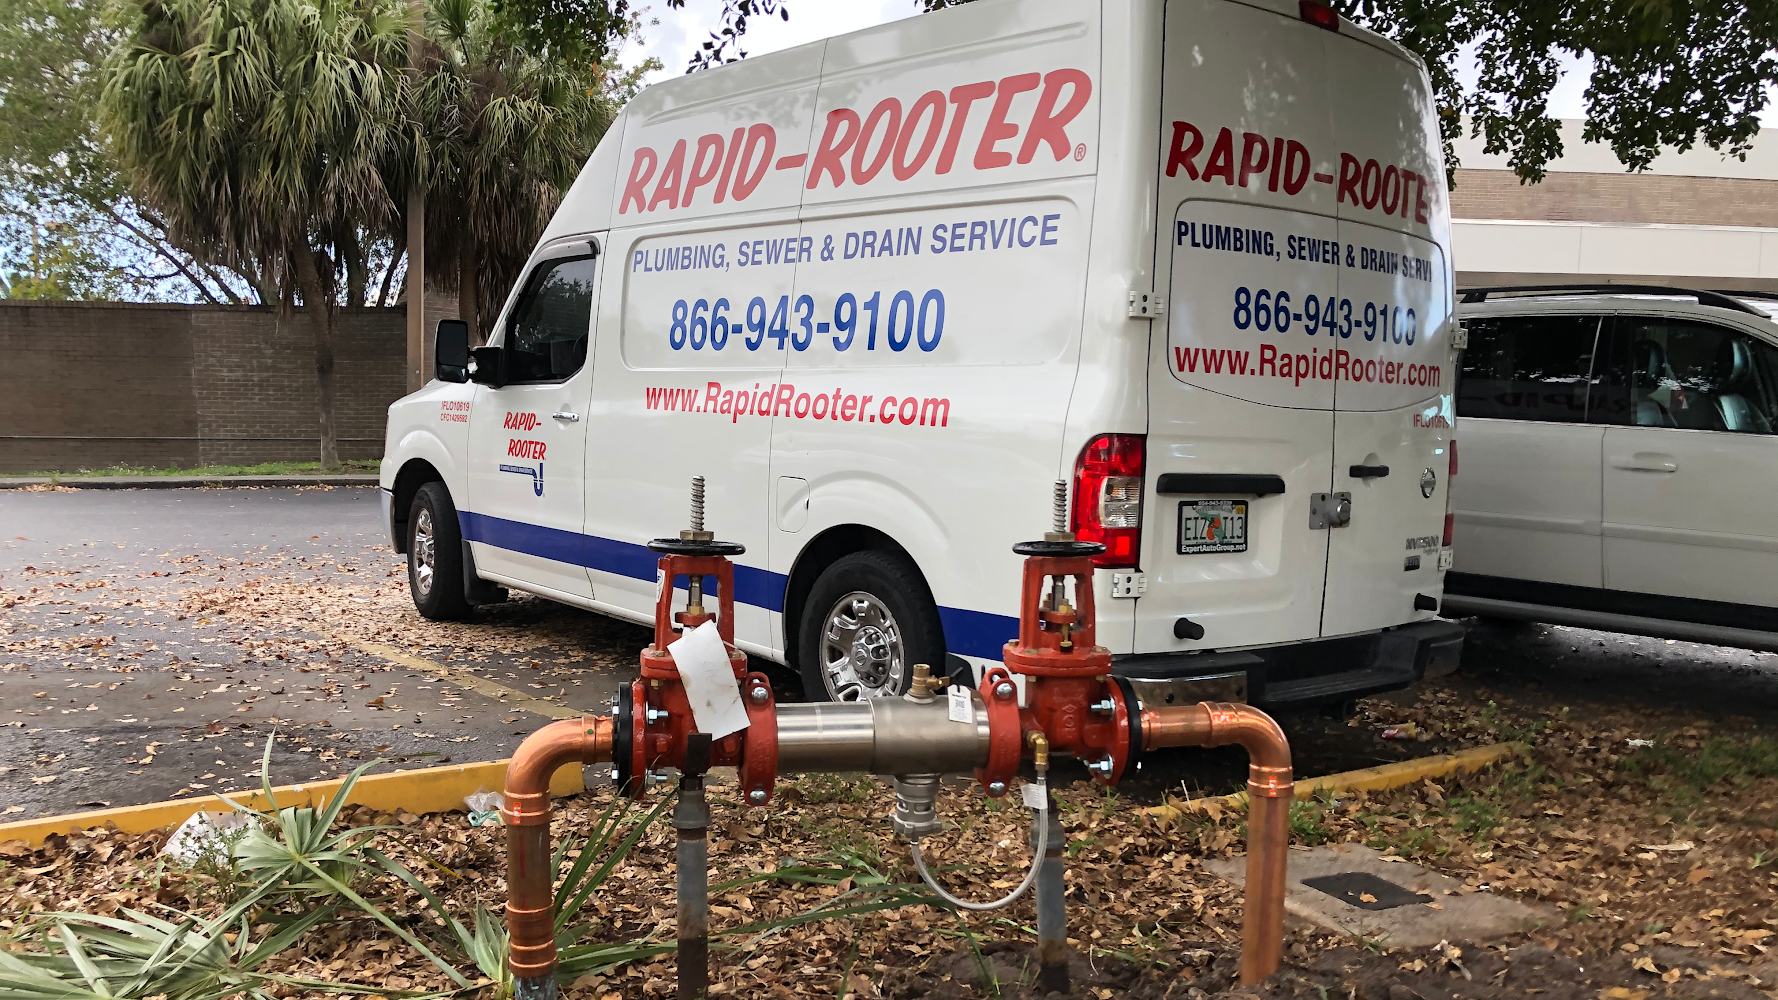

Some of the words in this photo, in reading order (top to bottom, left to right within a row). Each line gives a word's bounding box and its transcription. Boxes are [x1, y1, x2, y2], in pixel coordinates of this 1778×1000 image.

[1166, 121, 1433, 224] RAPID-ROOTE
[633, 243, 730, 273] PLUMBING,
[737, 236, 812, 267] SEWER
[820, 233, 835, 261] &
[844, 227, 922, 259] DRAIN
[931, 213, 1061, 254] SERVICE
[1177, 220, 1281, 262] PLUMBING,
[1287, 235, 1341, 266] SEWER
[1346, 247, 1356, 268] &
[1361, 246, 1398, 276] DRAIN
[1402, 254, 1432, 283] SERVI
[669, 288, 946, 352] 866-943-9100
[1234, 286, 1416, 346] 866-943-9100
[1175, 343, 1441, 387] www.RapidRooter.com
[503, 411, 542, 431] RAPID-
[645, 381, 951, 428] www.RapidRooter.com
[507, 439, 546, 460] ROOTER
[1181, 544, 1246, 553] ExpertAutoGroup.net
